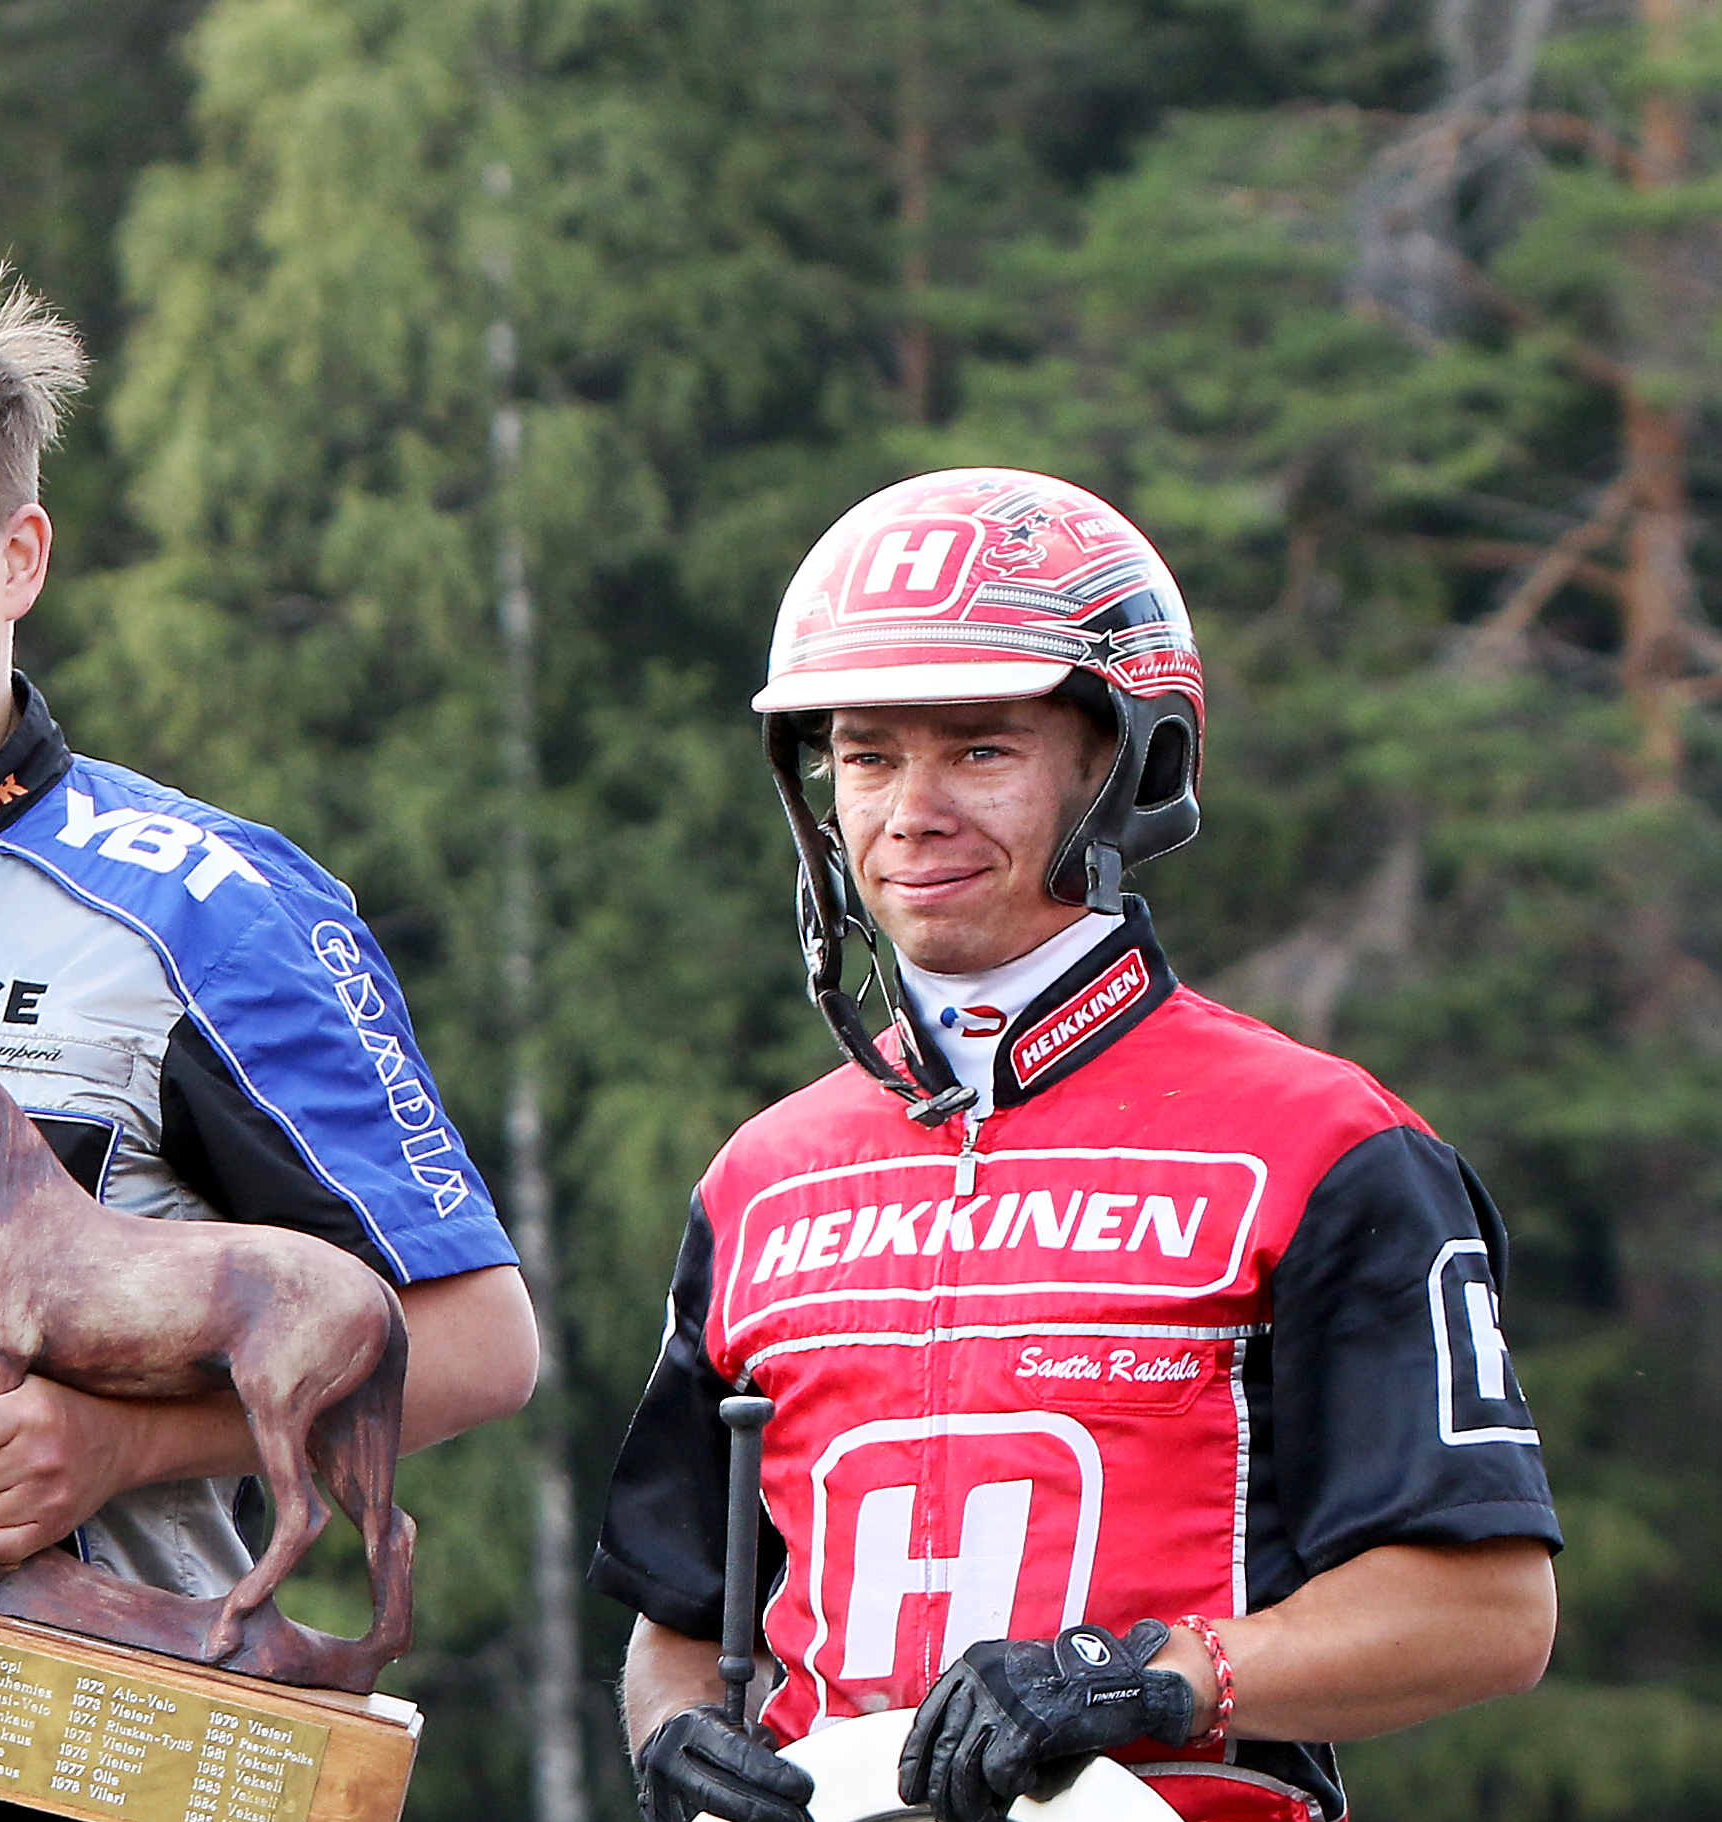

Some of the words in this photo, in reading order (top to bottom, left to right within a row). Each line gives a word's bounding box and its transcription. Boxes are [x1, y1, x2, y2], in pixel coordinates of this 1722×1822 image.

[864, 530, 957, 593] H
[56, 787, 271, 904] YBT
[1021, 964, 1140, 1069] HEIKKINEN
[311, 920, 470, 1218] GRADIA
[752, 1188, 1209, 1286] HEIKKINEN
[1015, 1346, 1102, 1380] Santtu
[1108, 1349, 1200, 1382] Raitala
[840, 1478, 1034, 1681] H
[76, 1677, 105, 1695] 1972
[72, 1694, 101, 1711] 1973
[1092, 1688, 1142, 1703] FINNTACK
[68, 1710, 97, 1728] 1974
[210, 1712, 239, 1729] 1979
[64, 1726, 92, 1743] 1975
[205, 1728, 234, 1746] 1980
[60, 1743, 89, 1760] 1976
[201, 1744, 227, 1761] 1981
[56, 1759, 86, 1776] 1977
[197, 1761, 226, 1778] 1982
[51, 1776, 81, 1794] 1978
[192, 1777, 222, 1795] 1983
[188, 1794, 217, 1812] 1984
